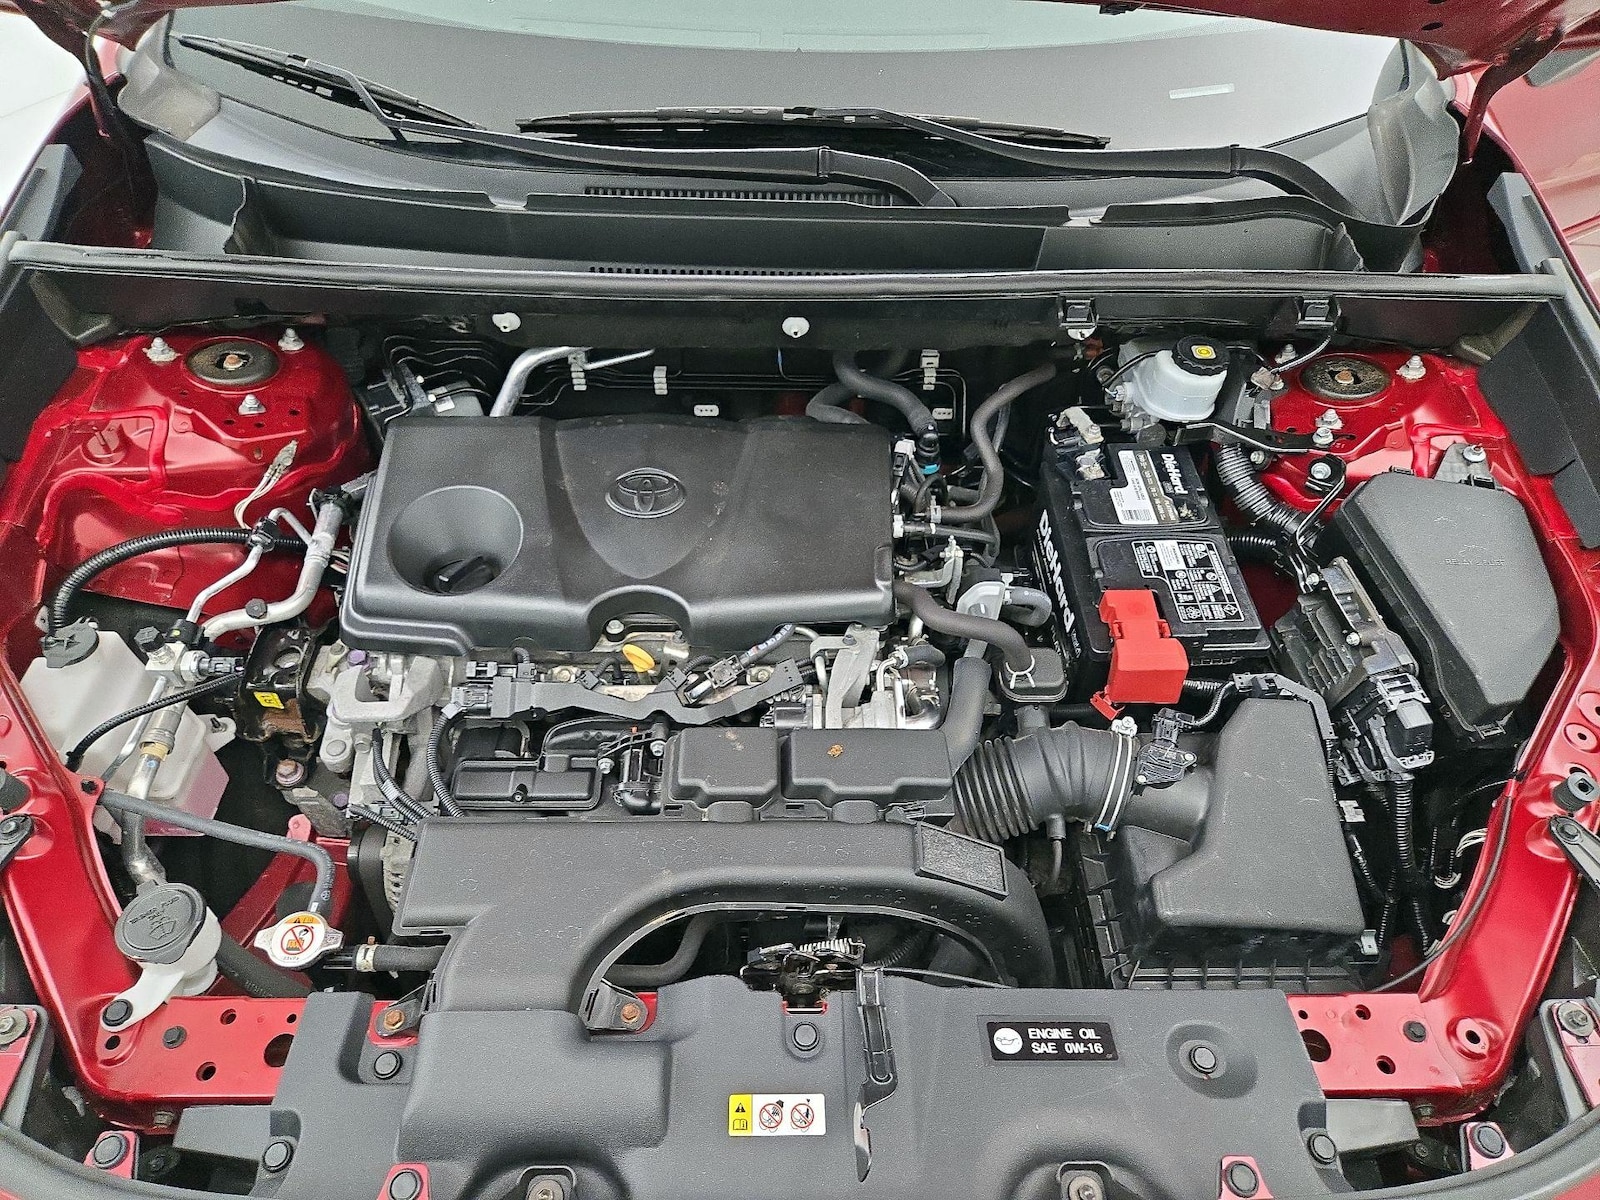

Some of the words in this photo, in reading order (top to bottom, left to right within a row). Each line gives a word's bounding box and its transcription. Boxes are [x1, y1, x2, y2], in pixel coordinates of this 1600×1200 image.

[1161, 453, 1189, 495] DieHard
[1039, 509, 1076, 634] DieHard
[1027, 1028, 1073, 1039] ENGINE
[1078, 1028, 1101, 1039] OIL
[1031, 1043, 1059, 1054] SAE
[1064, 1042, 1104, 1054] 0W-16
